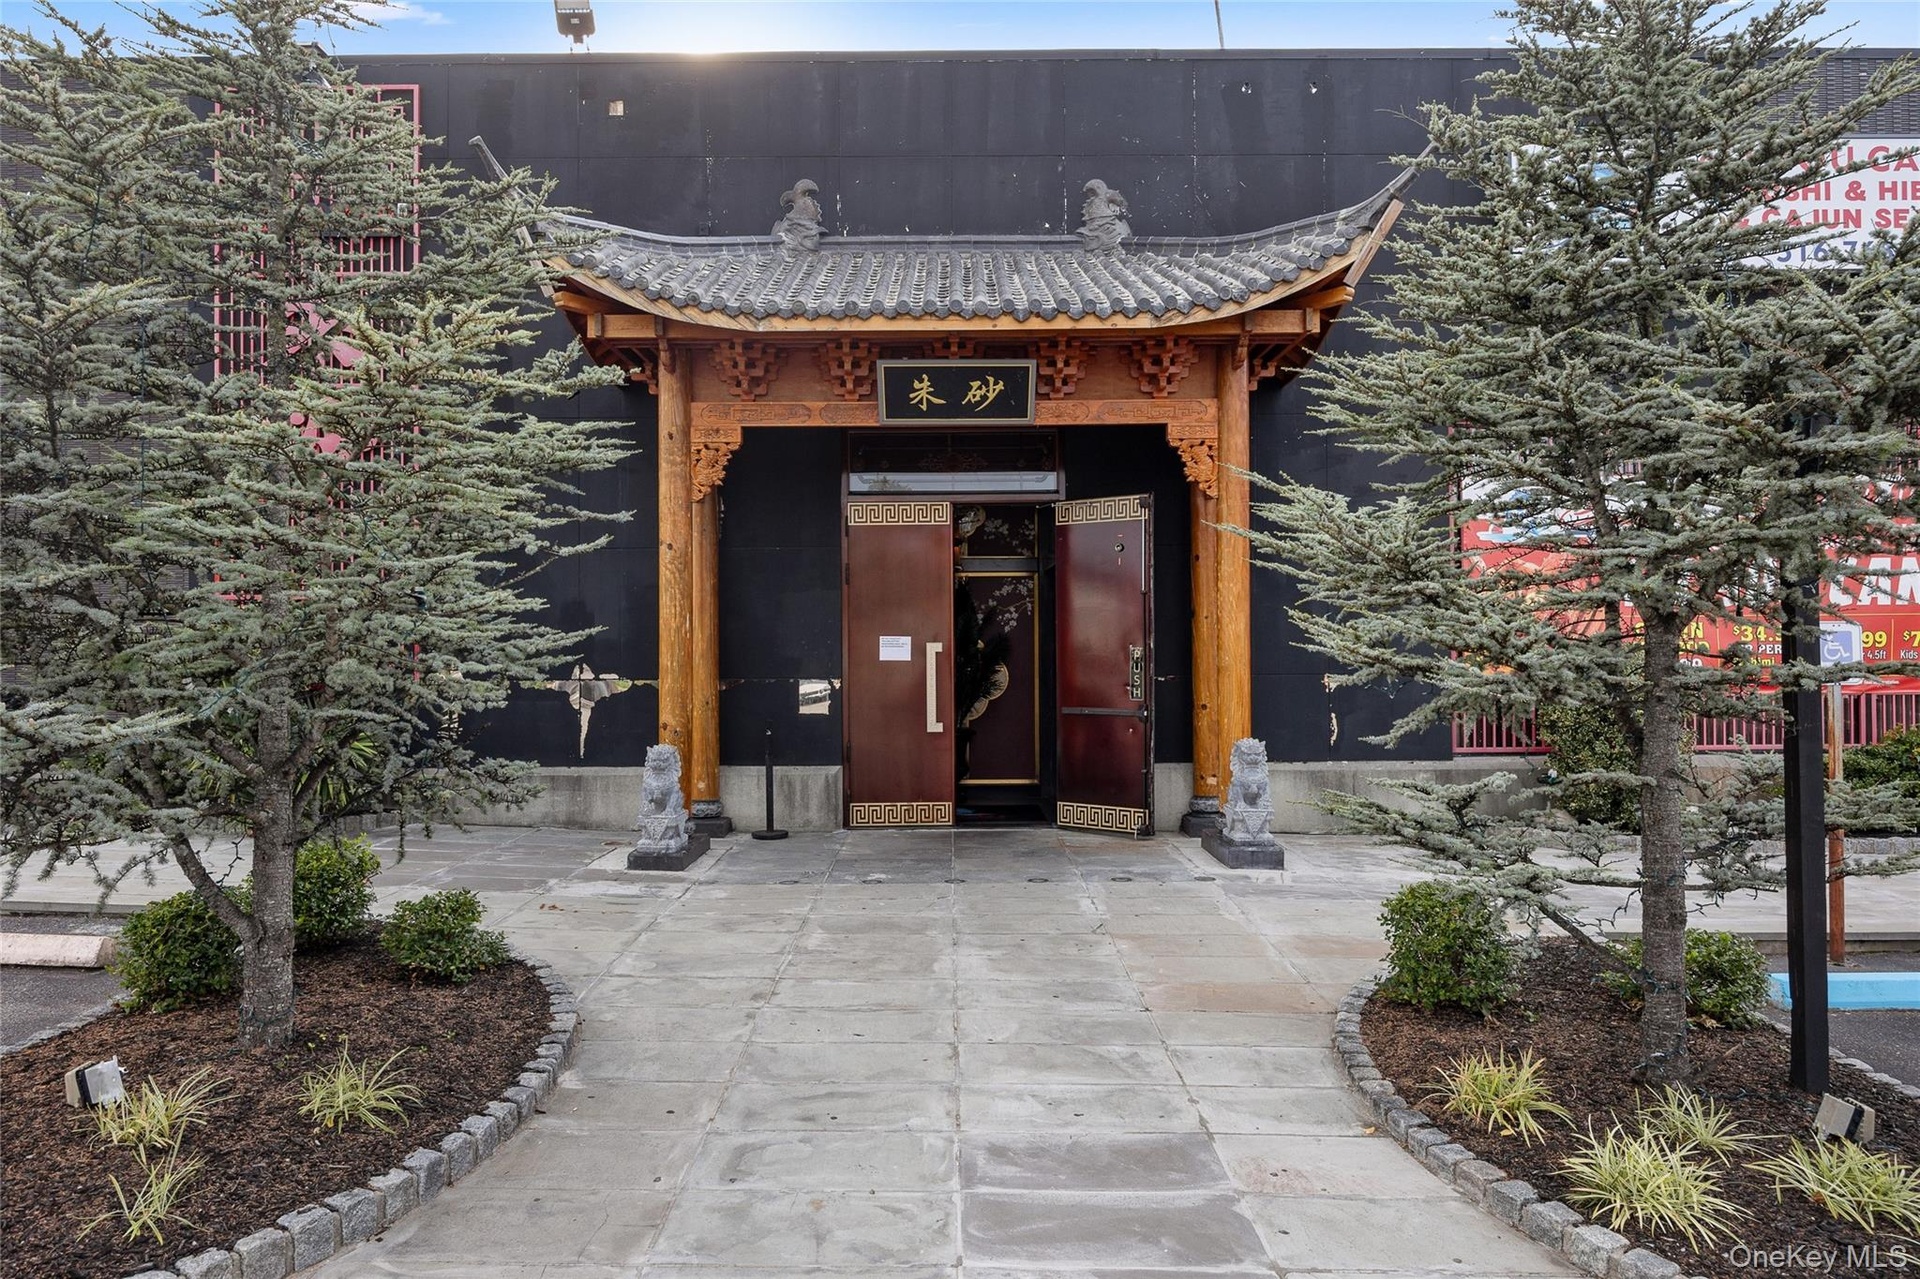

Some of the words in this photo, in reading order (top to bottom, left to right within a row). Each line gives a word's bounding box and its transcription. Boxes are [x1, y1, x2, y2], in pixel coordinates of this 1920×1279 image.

[1845, 180, 1866, 201] &
[908, 373, 1005, 412] 朱砂
[1900, 650, 1919, 660] Kids
[1133, 650, 1141, 698] PUSH
